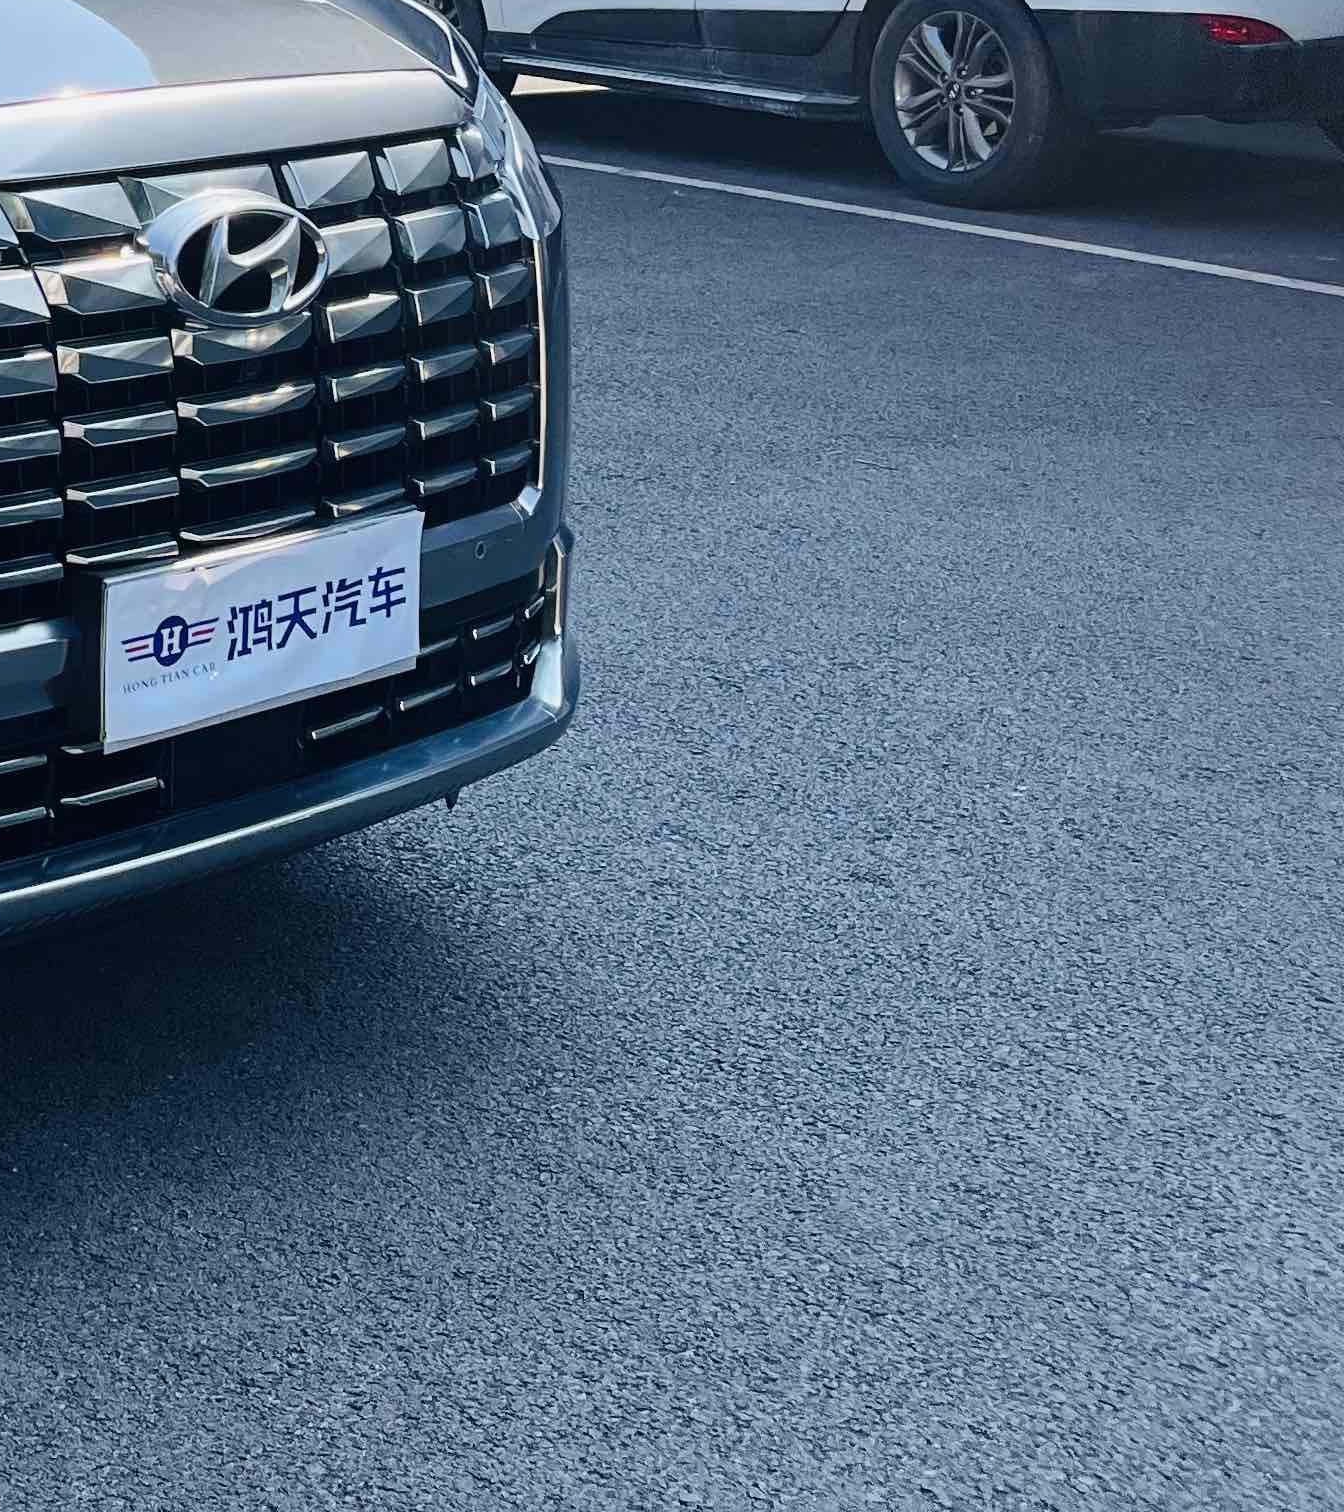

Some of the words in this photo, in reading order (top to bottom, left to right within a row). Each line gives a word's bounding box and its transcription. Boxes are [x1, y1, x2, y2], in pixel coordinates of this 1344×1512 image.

[227, 566, 407, 661] 鸿天汽车
[122, 679, 158, 695] HONG
[160, 669, 189, 685] TIAN
